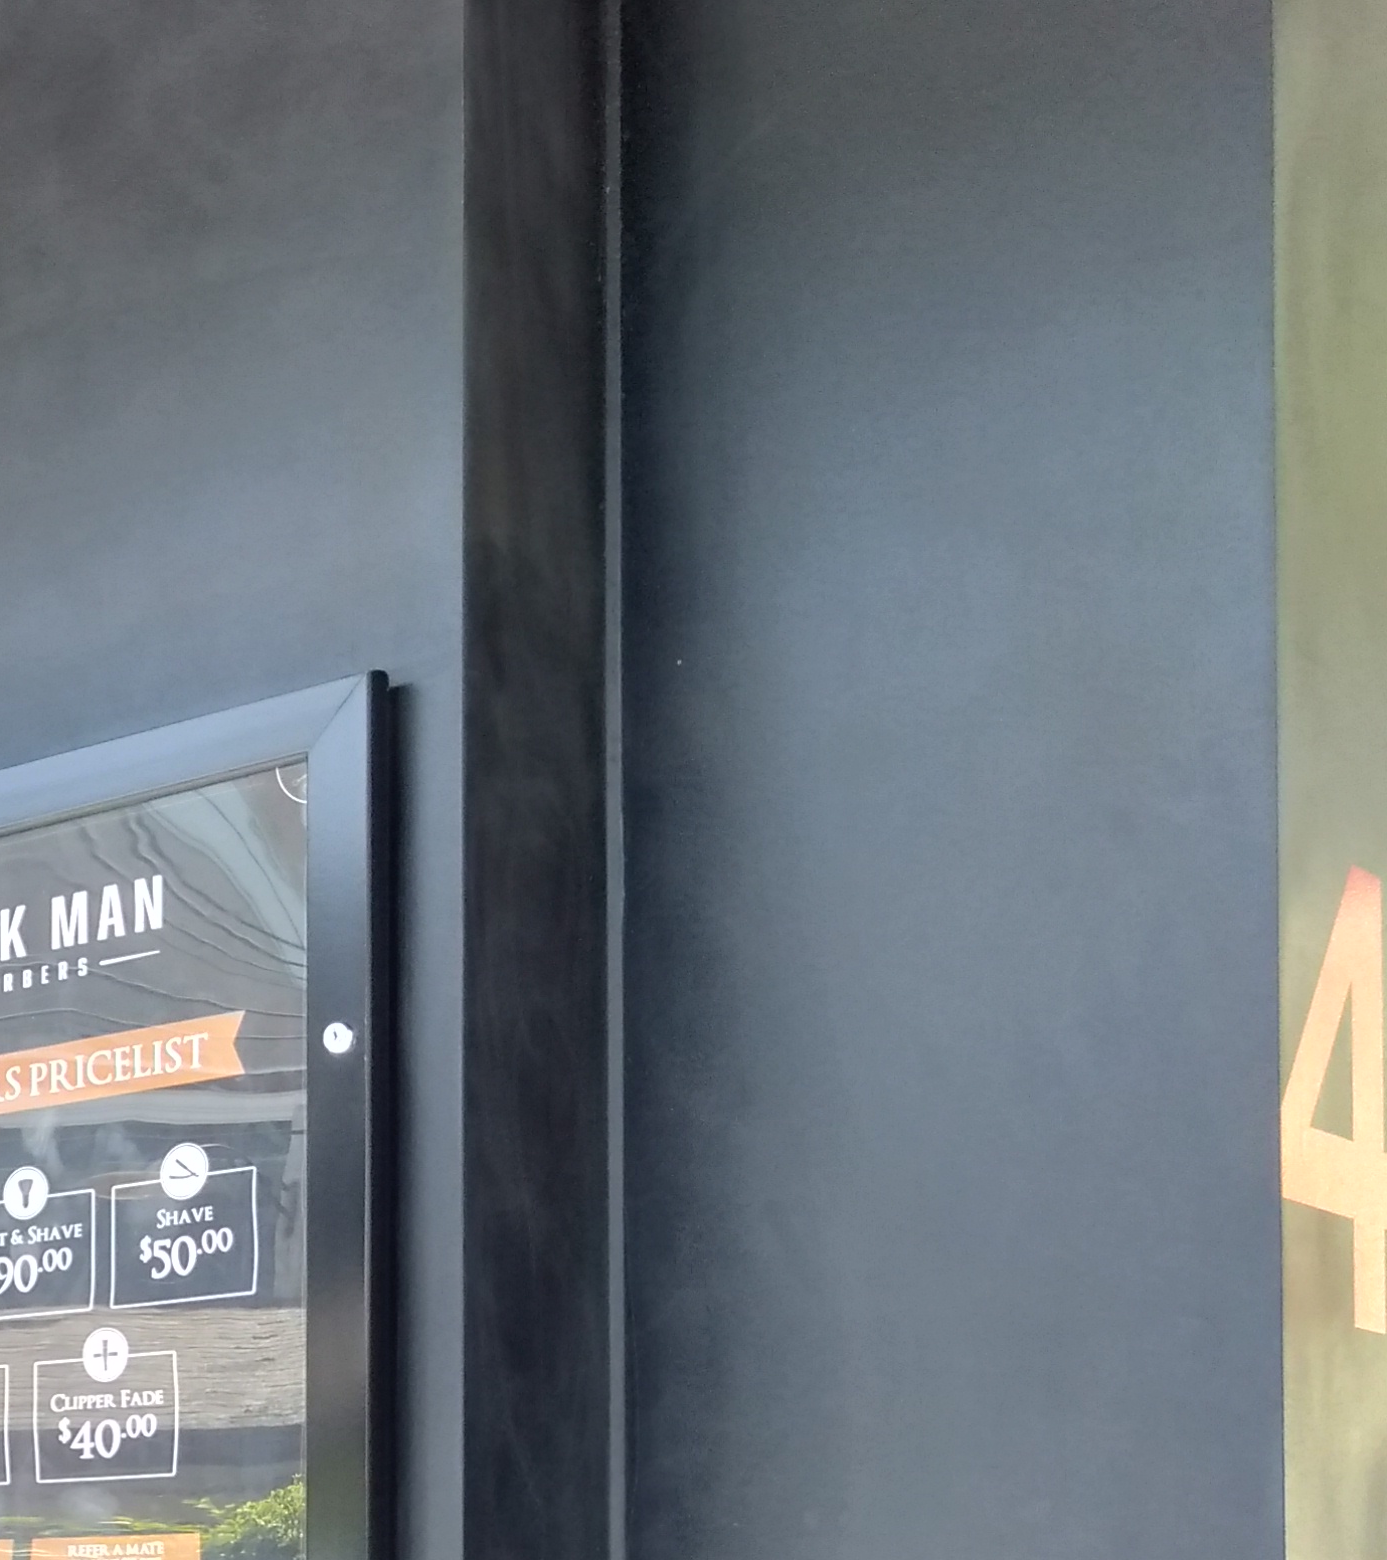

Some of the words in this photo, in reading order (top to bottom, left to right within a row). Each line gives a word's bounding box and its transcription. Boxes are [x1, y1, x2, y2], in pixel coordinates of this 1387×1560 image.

[51, 875, 163, 951] MAN
[29, 1033, 209, 1097] PRICELIST
[10, 1228, 24, 1246] &
[27, 1223, 82, 1244] SHAVE
[157, 1206, 214, 1229] SHAVE
[139, 1227, 233, 1280] $50.00
[50, 1393, 116, 1413] CLIPPER
[120, 1389, 164, 1408] FADE
[58, 1413, 157, 1460] $40.00
